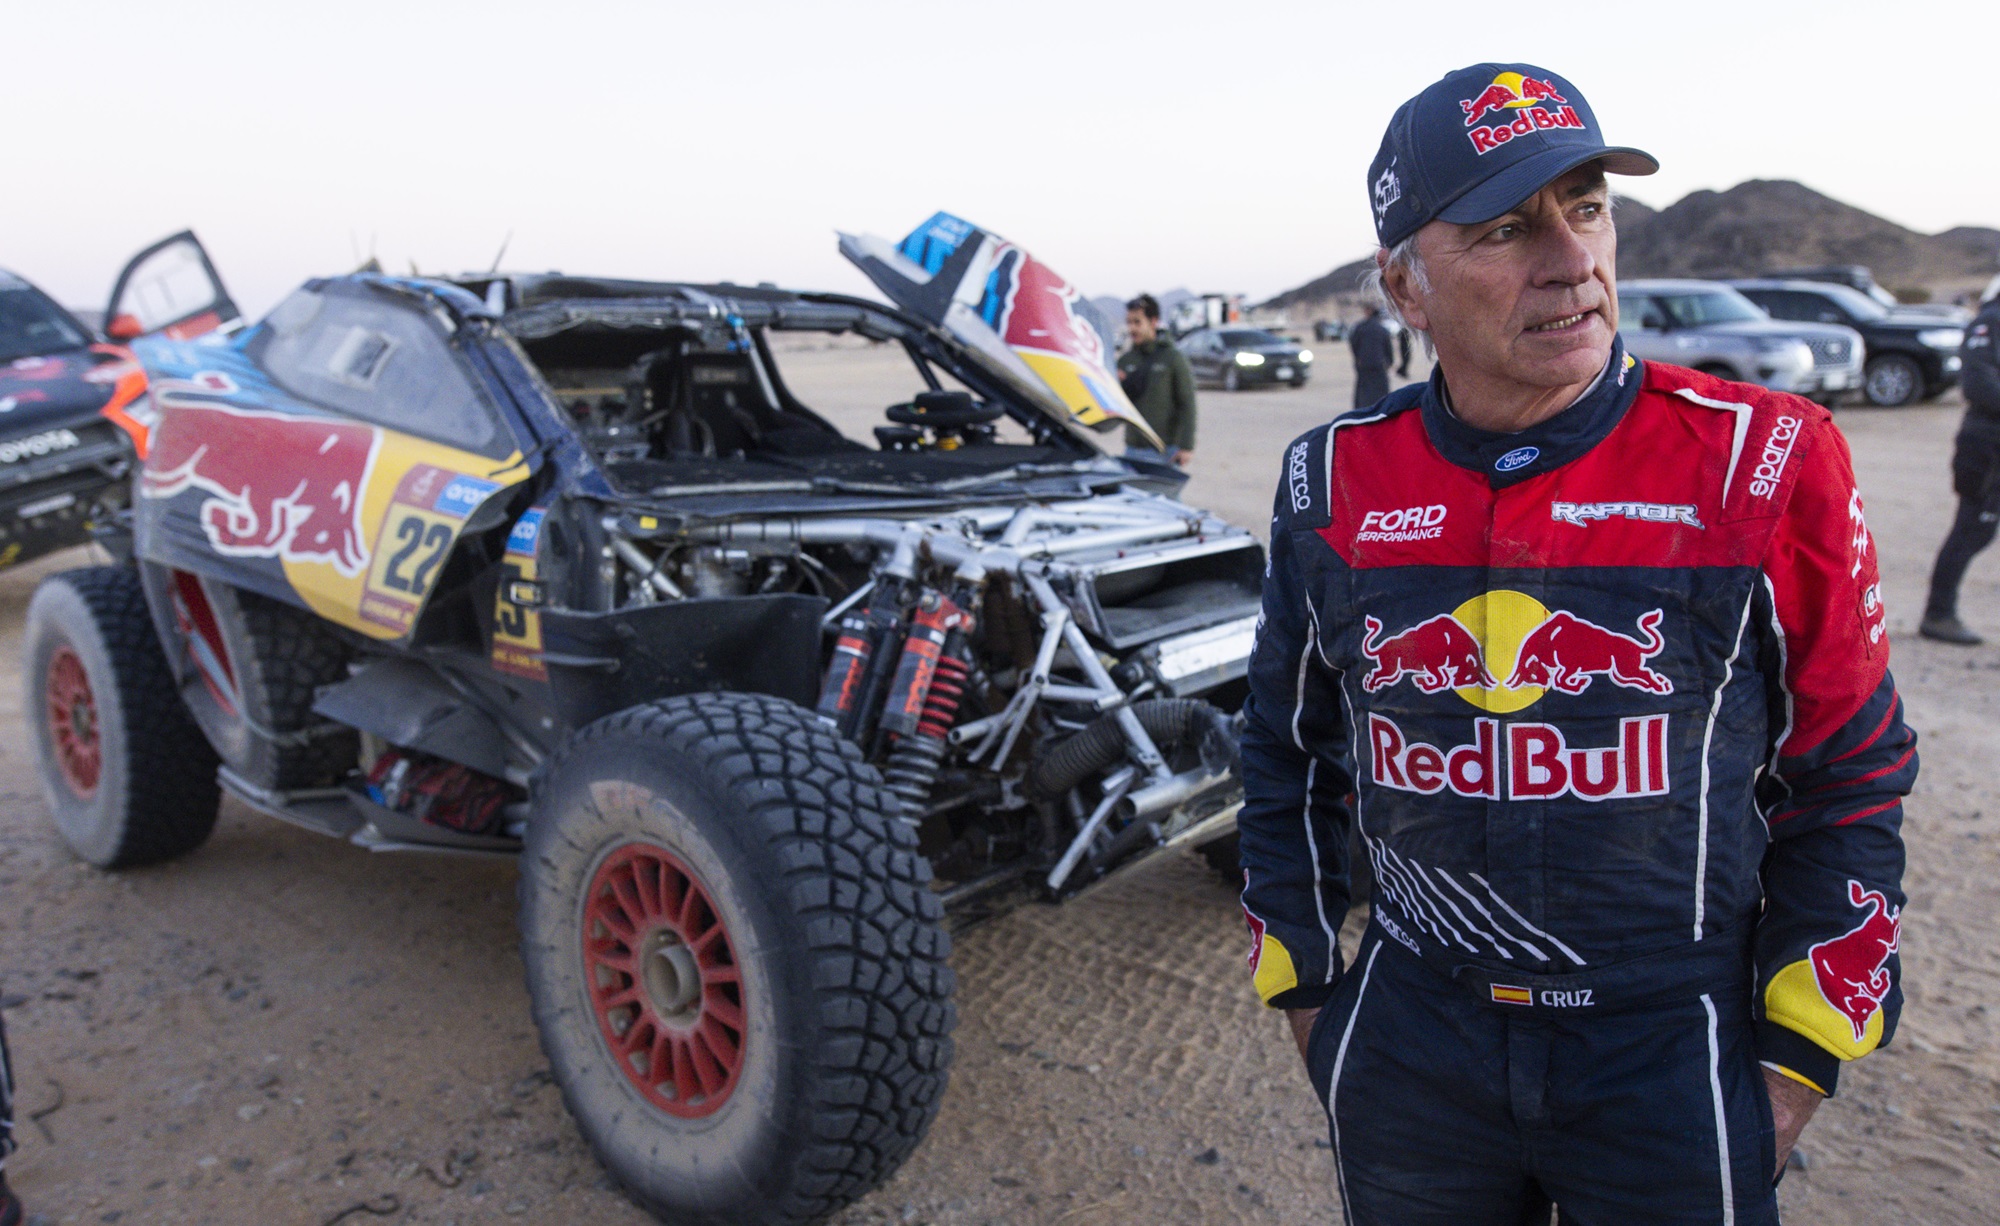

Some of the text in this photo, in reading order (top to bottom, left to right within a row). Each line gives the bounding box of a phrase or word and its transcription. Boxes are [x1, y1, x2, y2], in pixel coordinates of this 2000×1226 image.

[1468, 105, 1585, 155] Red Bull
[1290, 441, 1311, 513] sparco
[1503, 449, 1533, 468] Ford
[1750, 415, 1802, 500] sparco
[1356, 526, 1444, 543] PERFORMANCE
[1360, 504, 1447, 531] FORD
[1551, 501, 1705, 530] RAPTOR
[384, 514, 453, 596] 22
[1369, 713, 1669, 800] Red Bull
[1541, 988, 1595, 1007] CRUZ
